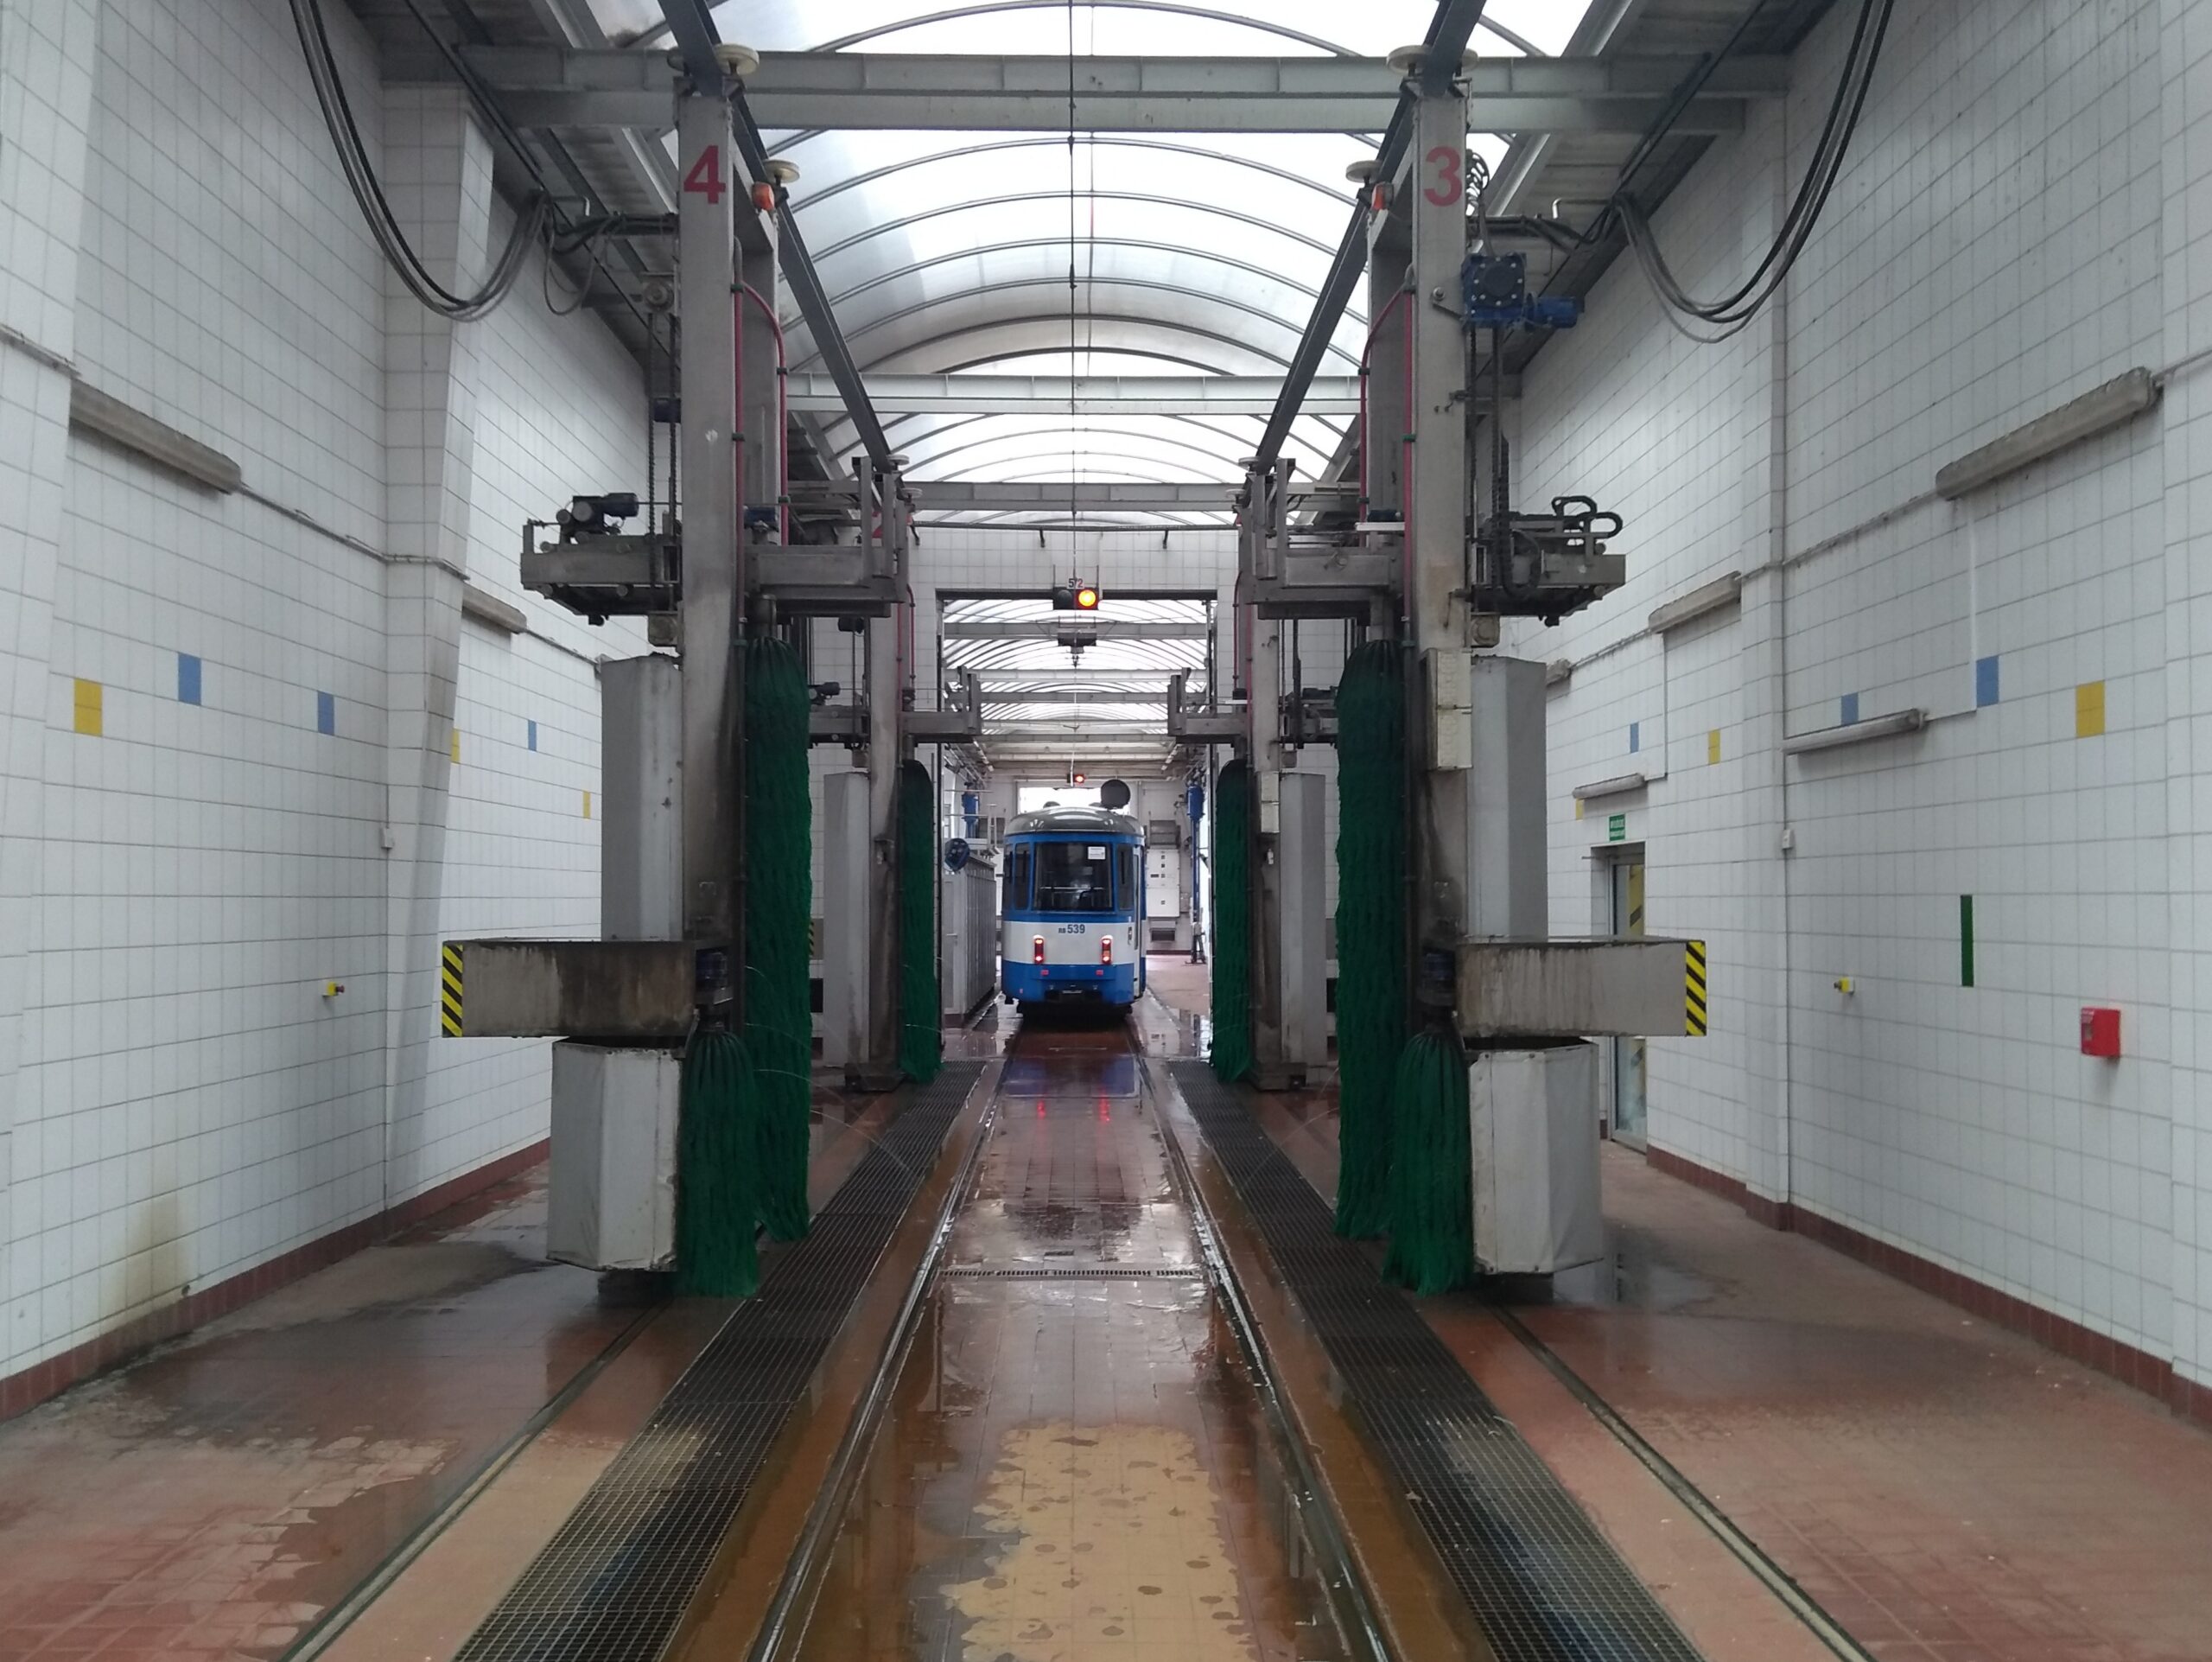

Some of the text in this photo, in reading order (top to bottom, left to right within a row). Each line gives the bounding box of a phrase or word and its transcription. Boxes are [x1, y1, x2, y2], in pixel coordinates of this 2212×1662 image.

[684, 145, 726, 204] 4
[1424, 145, 1462, 207] 3
[1067, 924, 1085, 934] 539
